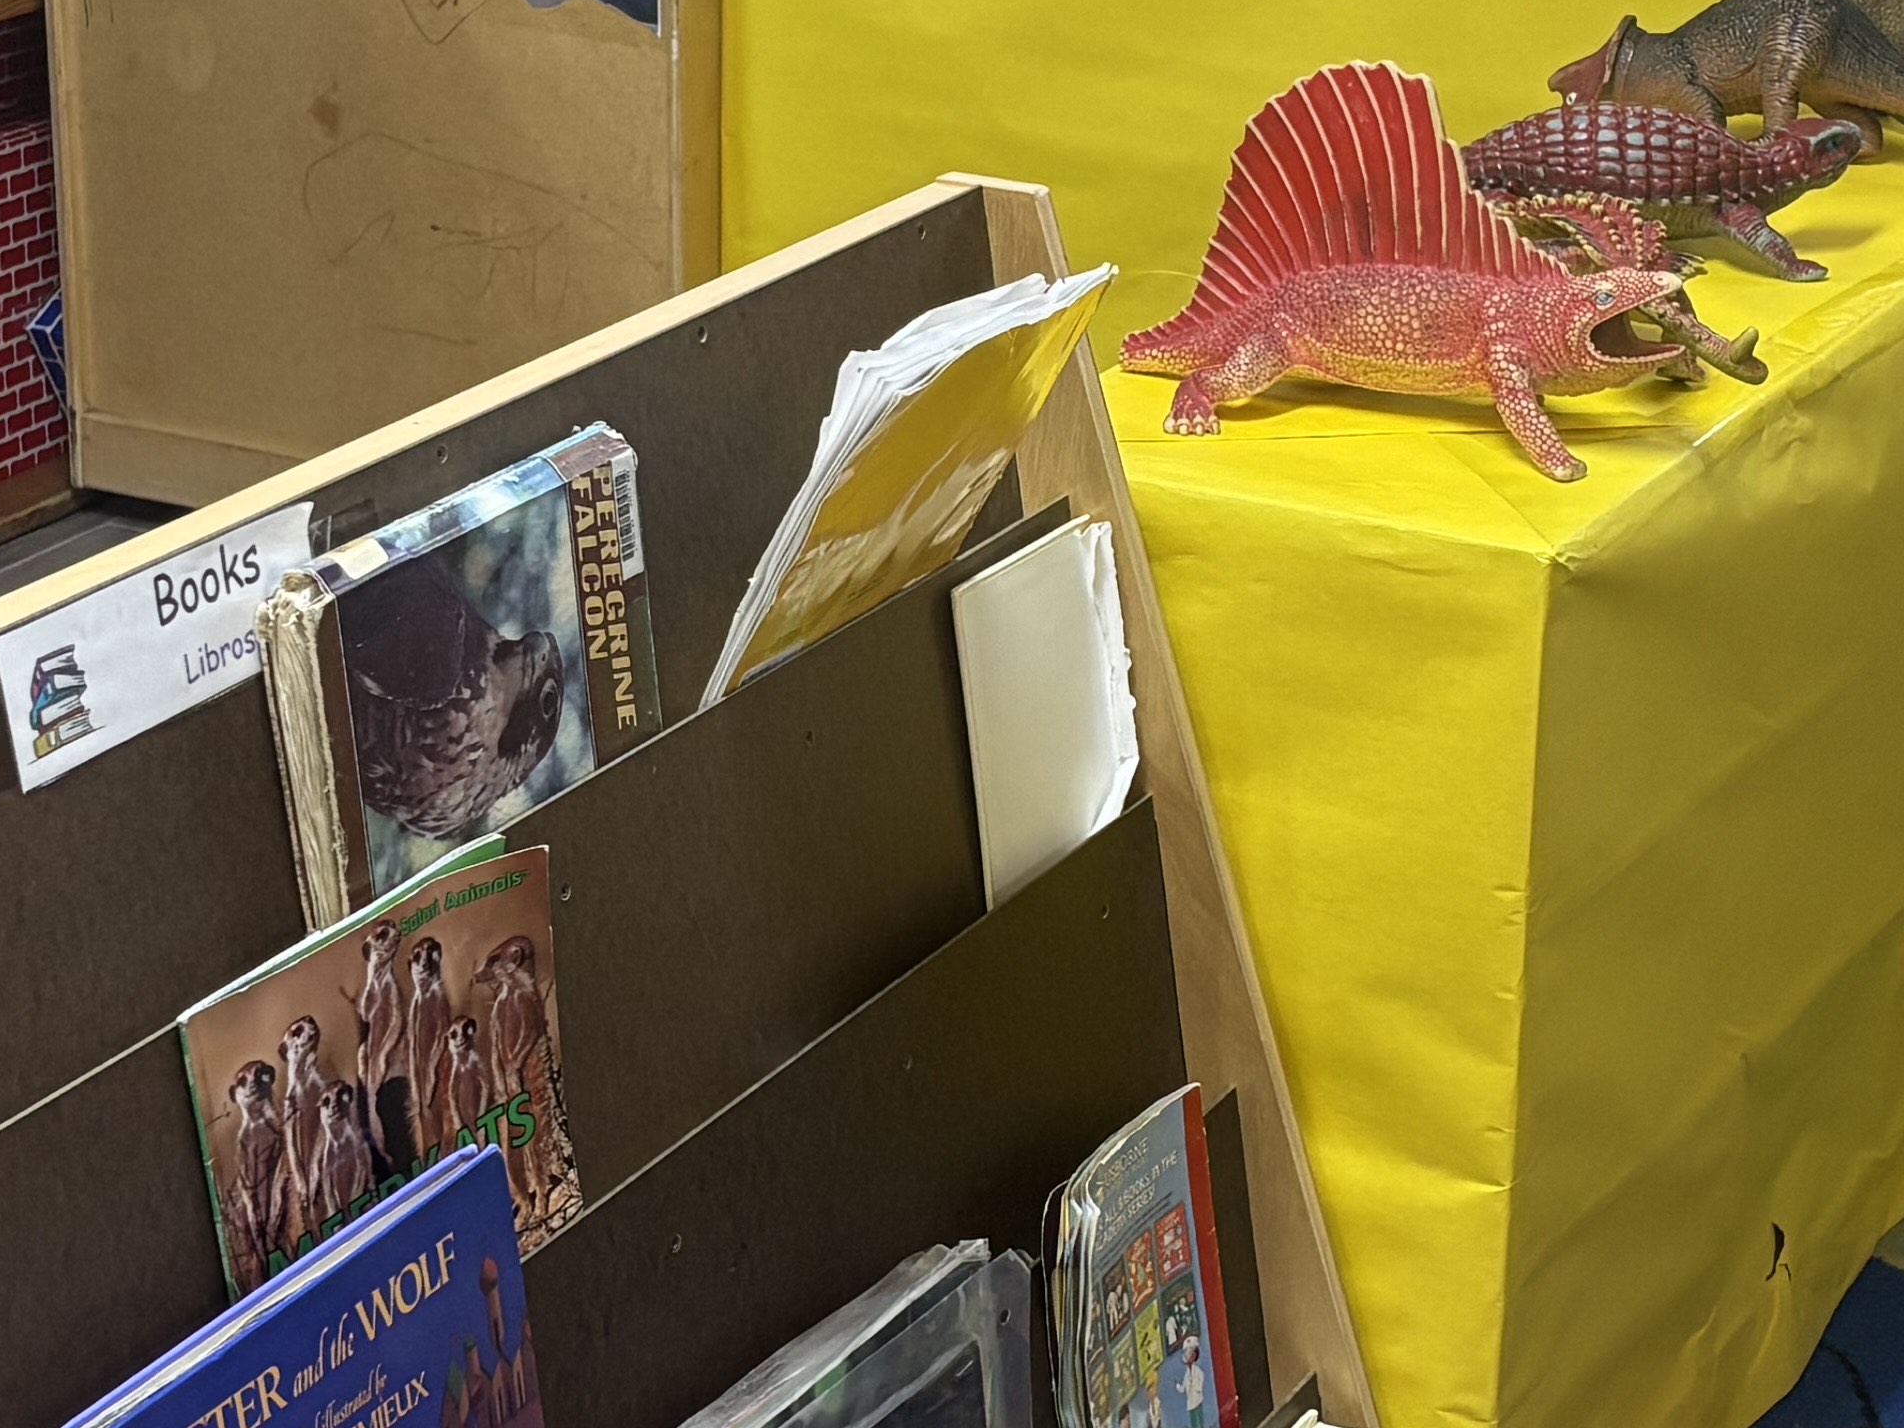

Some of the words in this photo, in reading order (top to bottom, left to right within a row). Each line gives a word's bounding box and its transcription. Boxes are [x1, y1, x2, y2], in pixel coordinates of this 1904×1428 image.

[153, 544, 261, 627] Books
[571, 475, 609, 661] FALCON
[593, 462, 638, 731] PEREGRINE
[183, 629, 256, 685] Libros
[444, 870, 524, 912] Animals
[293, 1326, 330, 1398] and
[330, 1312, 355, 1370] the
[355, 1231, 456, 1341] WOLF
